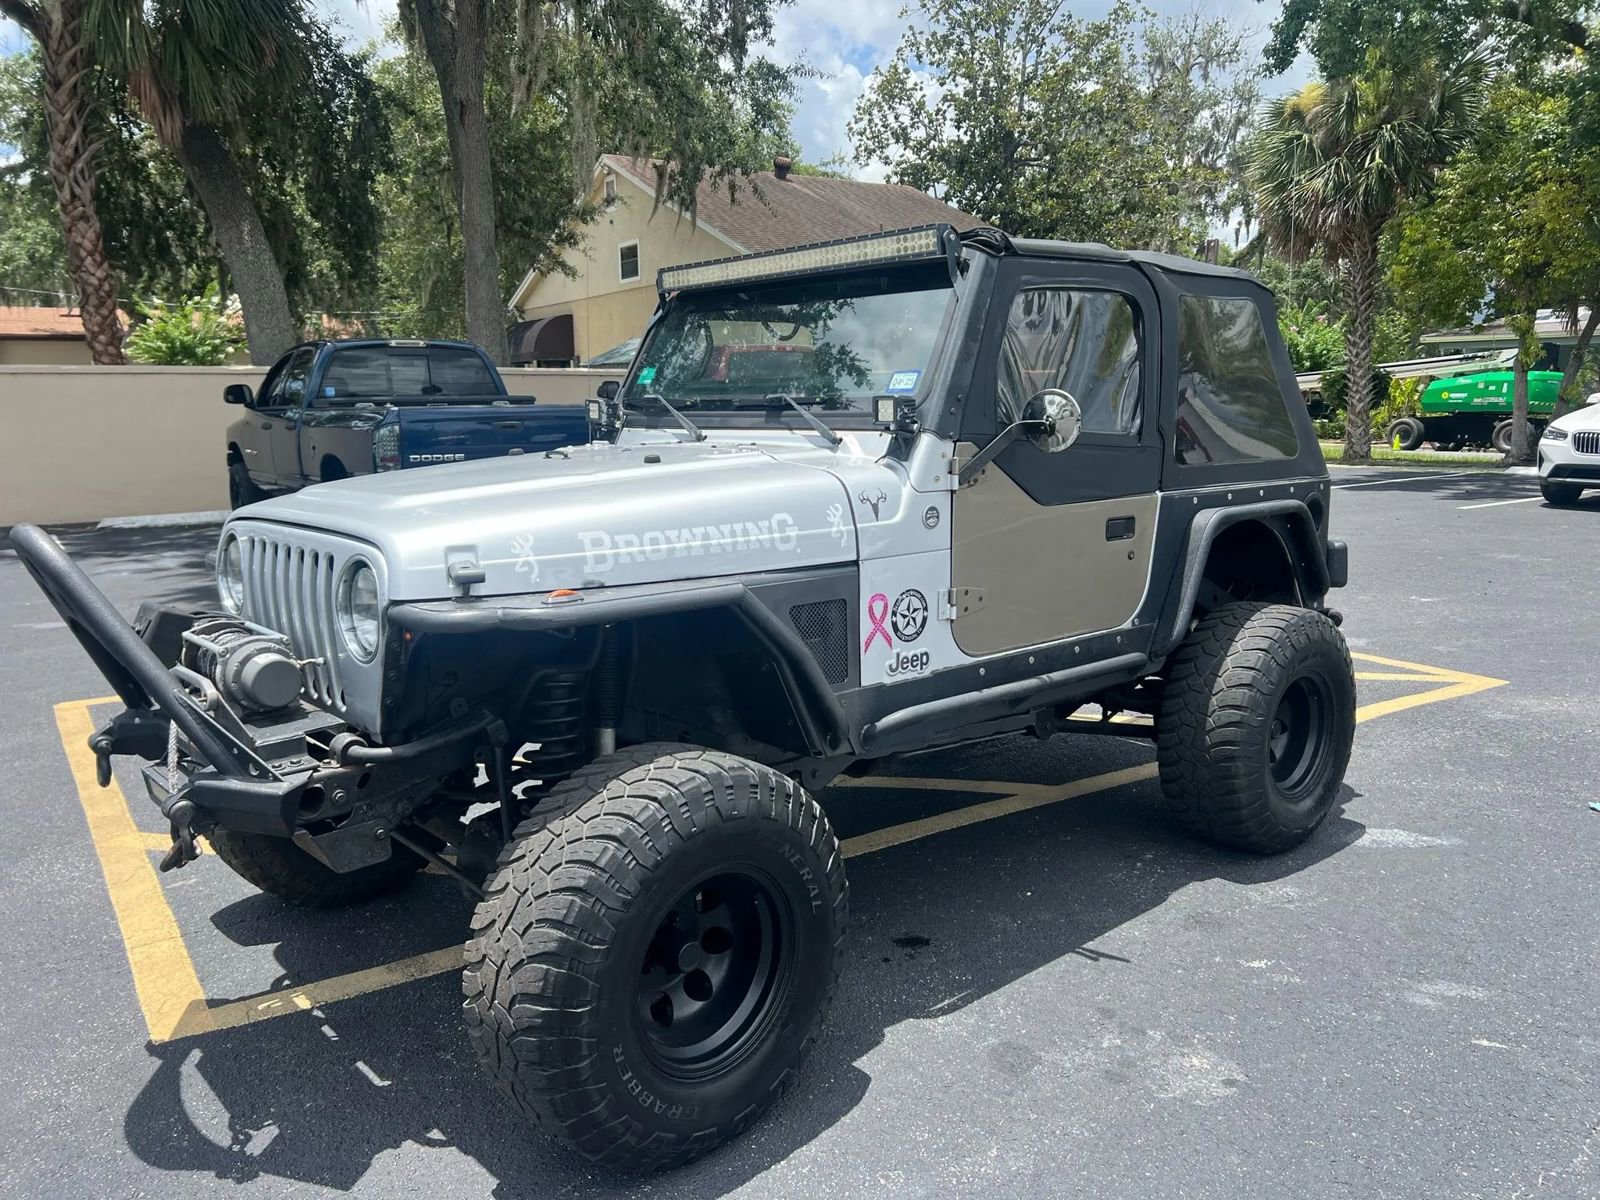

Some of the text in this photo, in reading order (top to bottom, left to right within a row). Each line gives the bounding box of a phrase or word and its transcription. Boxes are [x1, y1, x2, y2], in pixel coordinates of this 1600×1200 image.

[409, 453, 465, 462] DODGE
[577, 512, 799, 574] BROWNING
[888, 651, 930, 673] Jeep
[613, 1043, 699, 1119] GRABBER
